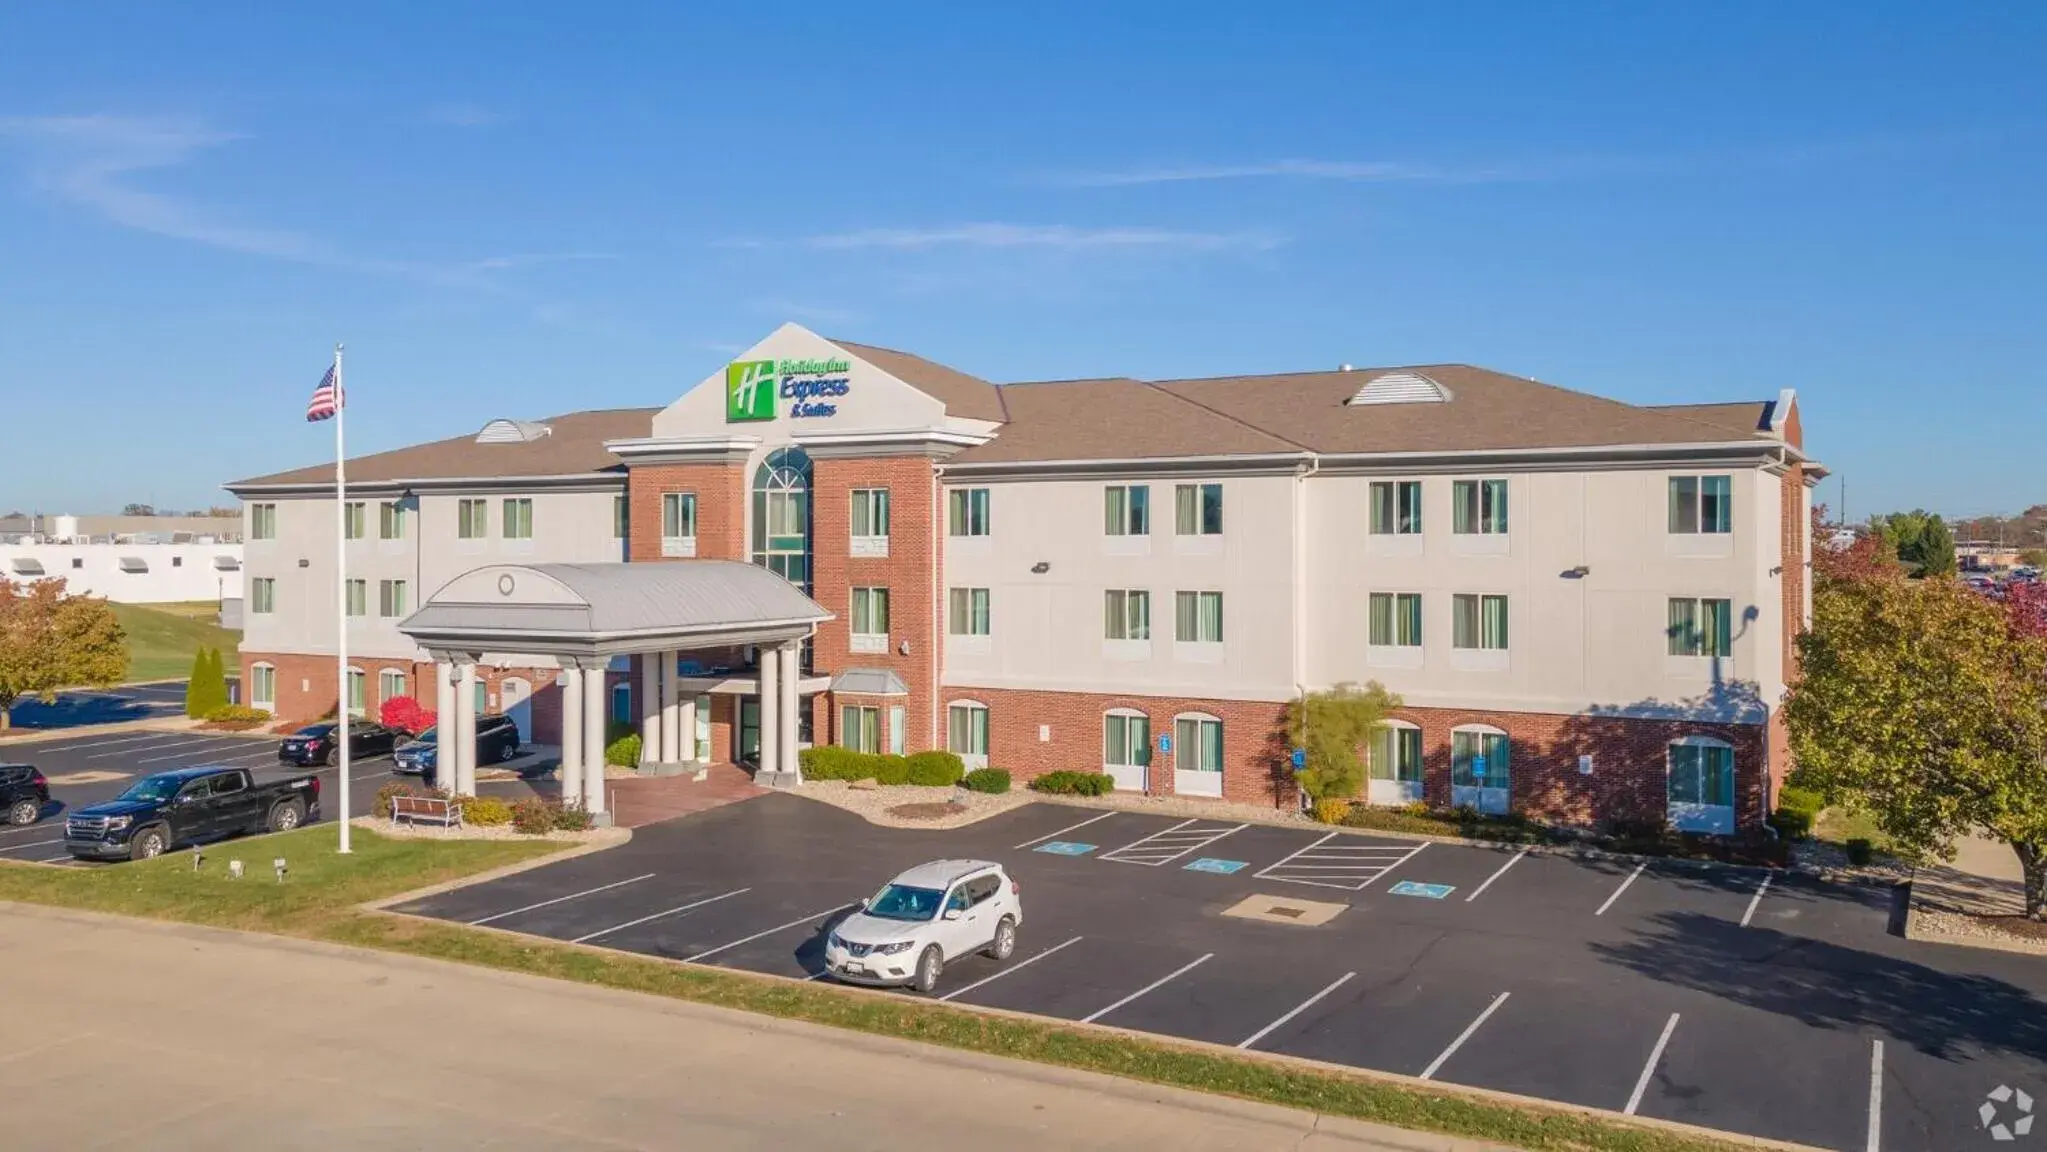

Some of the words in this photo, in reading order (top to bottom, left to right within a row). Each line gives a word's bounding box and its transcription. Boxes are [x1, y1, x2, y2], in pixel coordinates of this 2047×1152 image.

[780, 359, 826, 376] Holiday
[827, 357, 850, 372] Inn
[780, 376, 850, 403] Express
[790, 403, 801, 418] &
[801, 402, 837, 417] Suites
